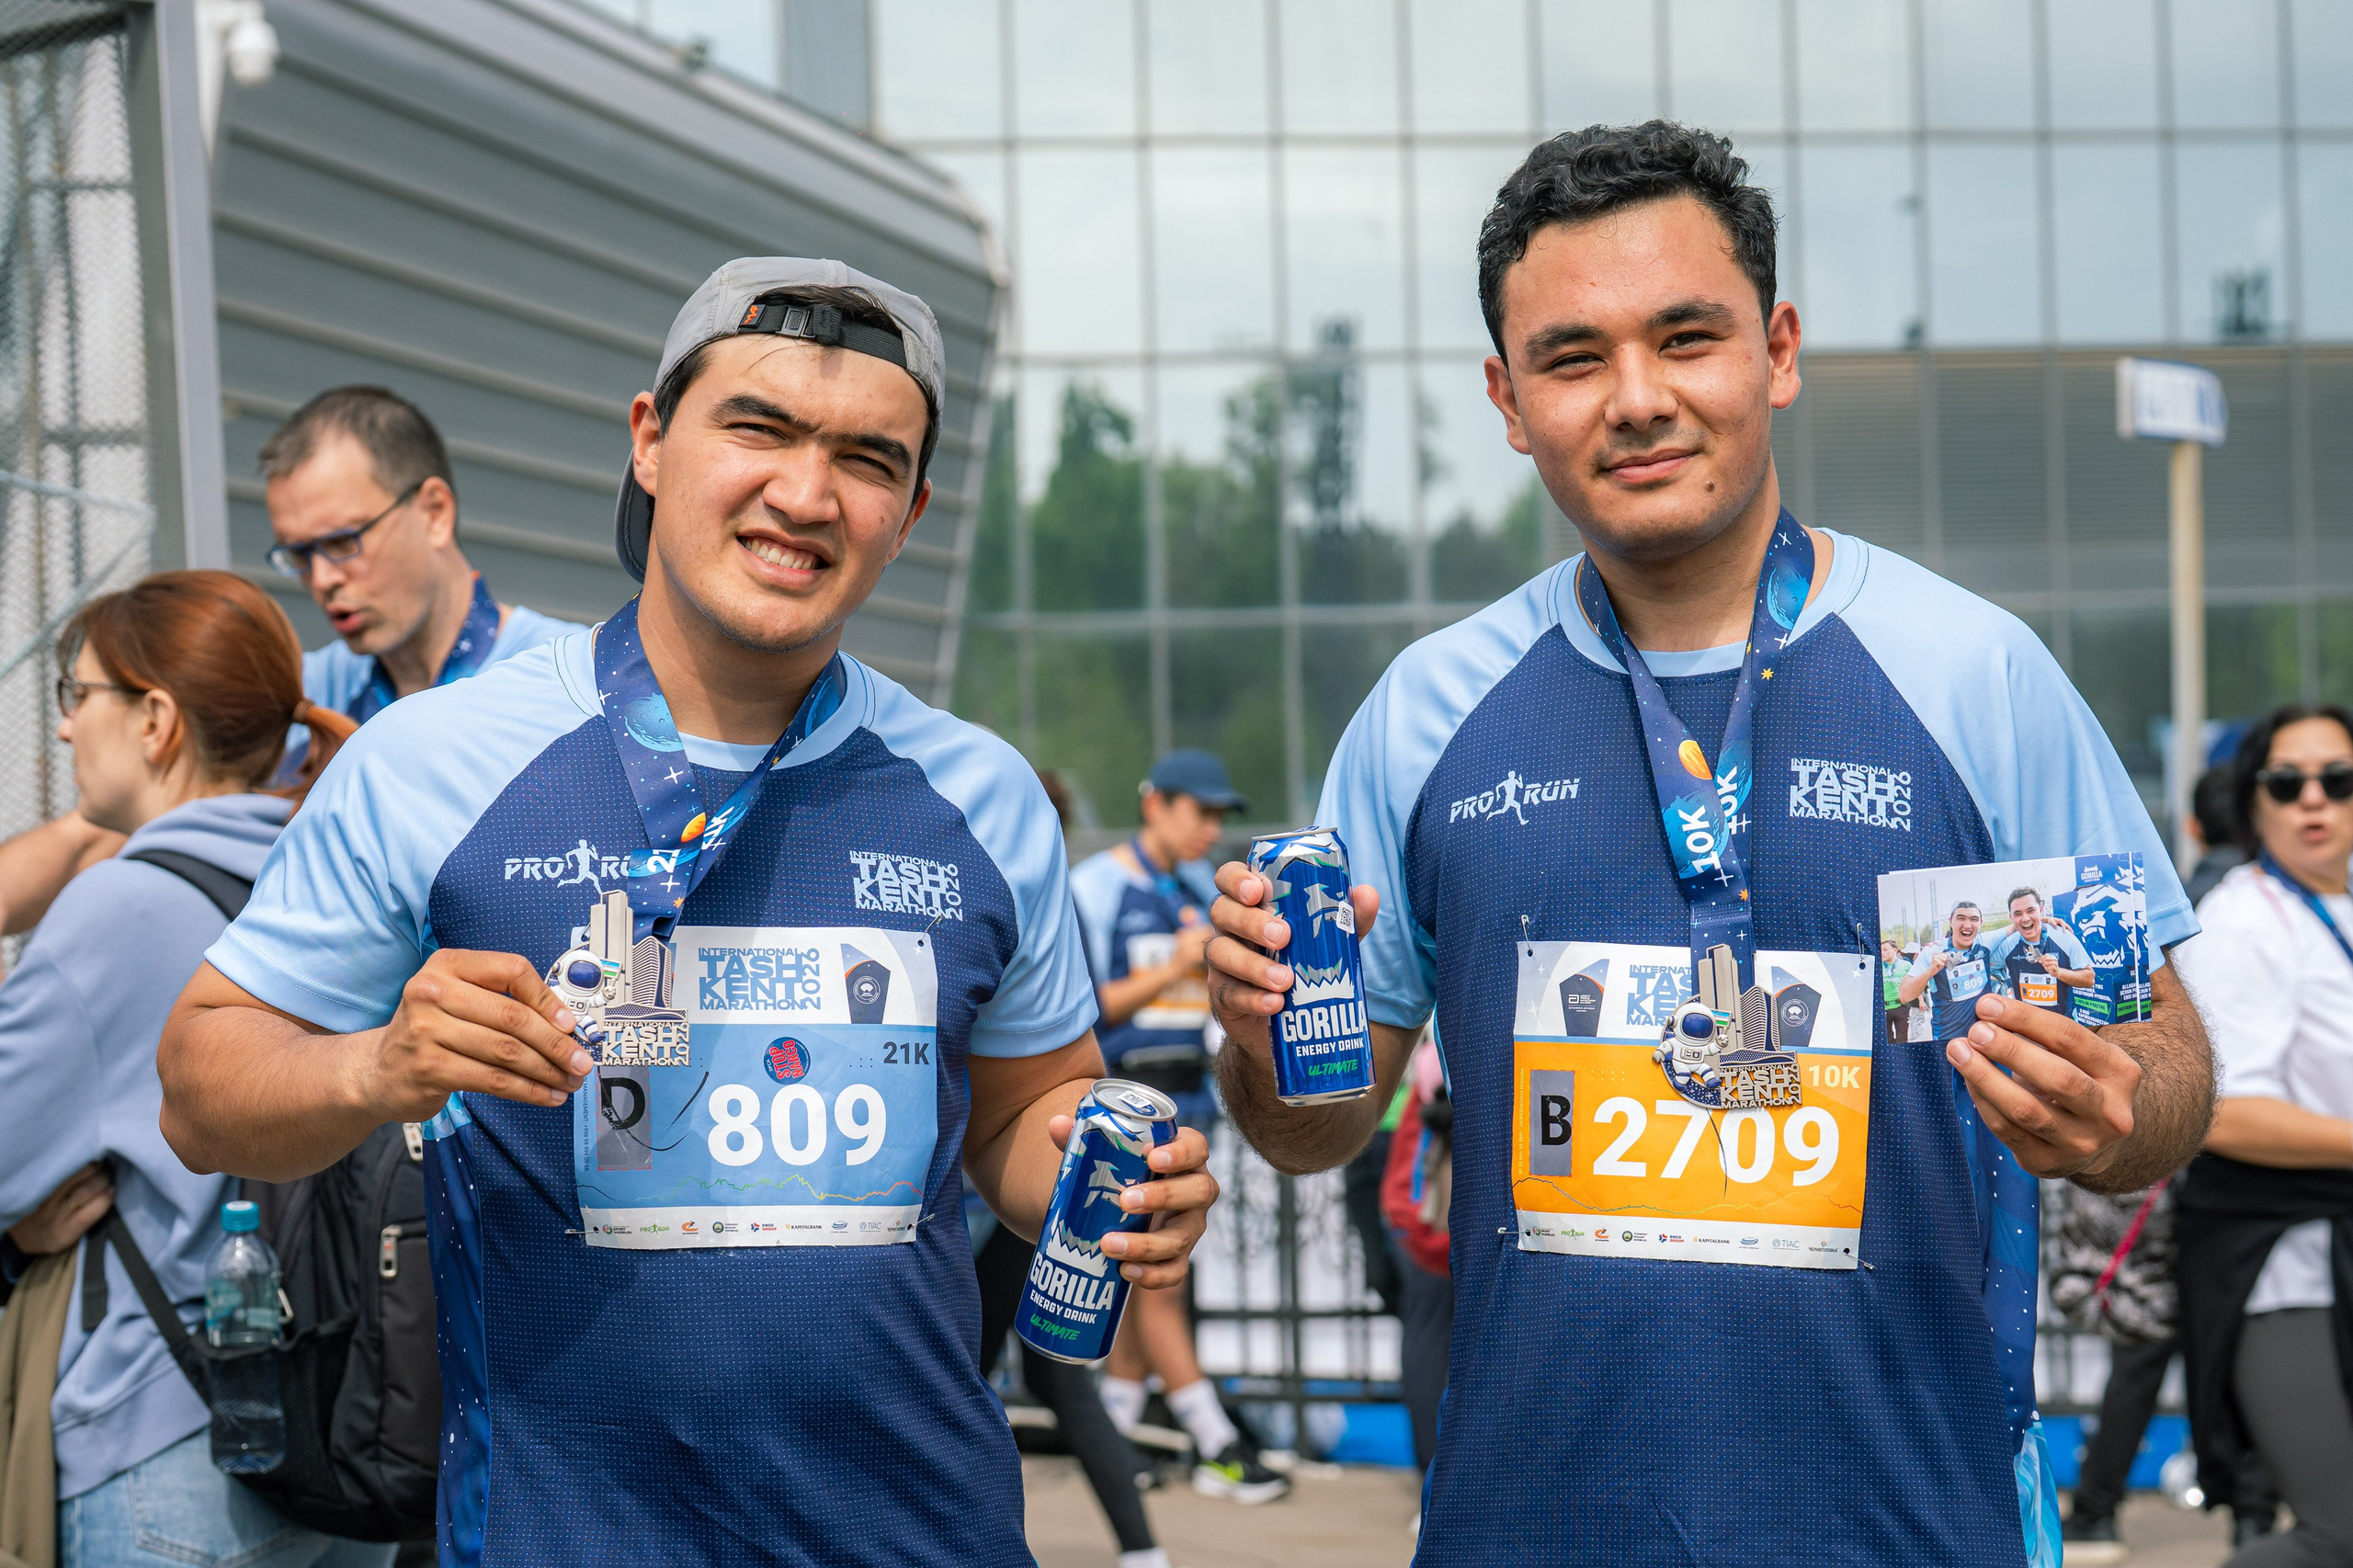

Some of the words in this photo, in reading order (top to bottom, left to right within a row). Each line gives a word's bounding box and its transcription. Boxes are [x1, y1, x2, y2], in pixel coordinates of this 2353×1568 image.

[1790, 757, 1891, 777] INTERNATIONAL
[1449, 790, 1495, 824] PRO
[1523, 778, 1582, 806] RUN
[1892, 771, 1912, 832] 2026
[1789, 806, 1895, 829] MARATHON
[1677, 804, 1722, 873] 10K
[504, 857, 564, 880] PRO
[849, 850, 940, 869] INTERNATIONAL
[2081, 869, 2103, 880] GORILLA
[944, 863, 963, 922] 2026
[856, 898, 950, 919] MARATHON
[699, 947, 798, 957] INTERNATIONAL
[699, 954, 802, 982] TASH
[801, 948, 821, 1010] 2026
[1630, 964, 1692, 975] INTERNAT
[699, 977, 802, 1002] KENT
[1630, 972, 1692, 996] TAS
[1963, 976, 1984, 990] 809
[2029, 988, 2055, 999] 2709
[699, 999, 804, 1010] MARATHON
[1281, 1000, 1368, 1042] GORILLA
[782, 1040, 805, 1078] NARCO
[883, 1041, 930, 1065] 21K
[1296, 1041, 1336, 1057] ENERGY
[1338, 1037, 1365, 1051] DRINK
[602, 1057, 677, 1066] MARATHON
[769, 1046, 791, 1079] STOP
[1308, 1059, 1358, 1077] ULTIMATE
[1808, 1064, 1861, 1089] 10K
[601, 1076, 646, 1130] D
[1722, 1097, 1791, 1109] MARATHON
[708, 1083, 886, 1166] 809
[1540, 1094, 1573, 1146] B
[1593, 1096, 1839, 1187] 2709
[868, 1221, 882, 1230] TIAC
[1781, 1239, 1800, 1248] TIAC
[1029, 1251, 1116, 1311] GORILLA
[1029, 1289, 1063, 1316] ENERGY
[1063, 1308, 1097, 1324] DRINK
[1029, 1313, 1081, 1341] ULTIMATE
